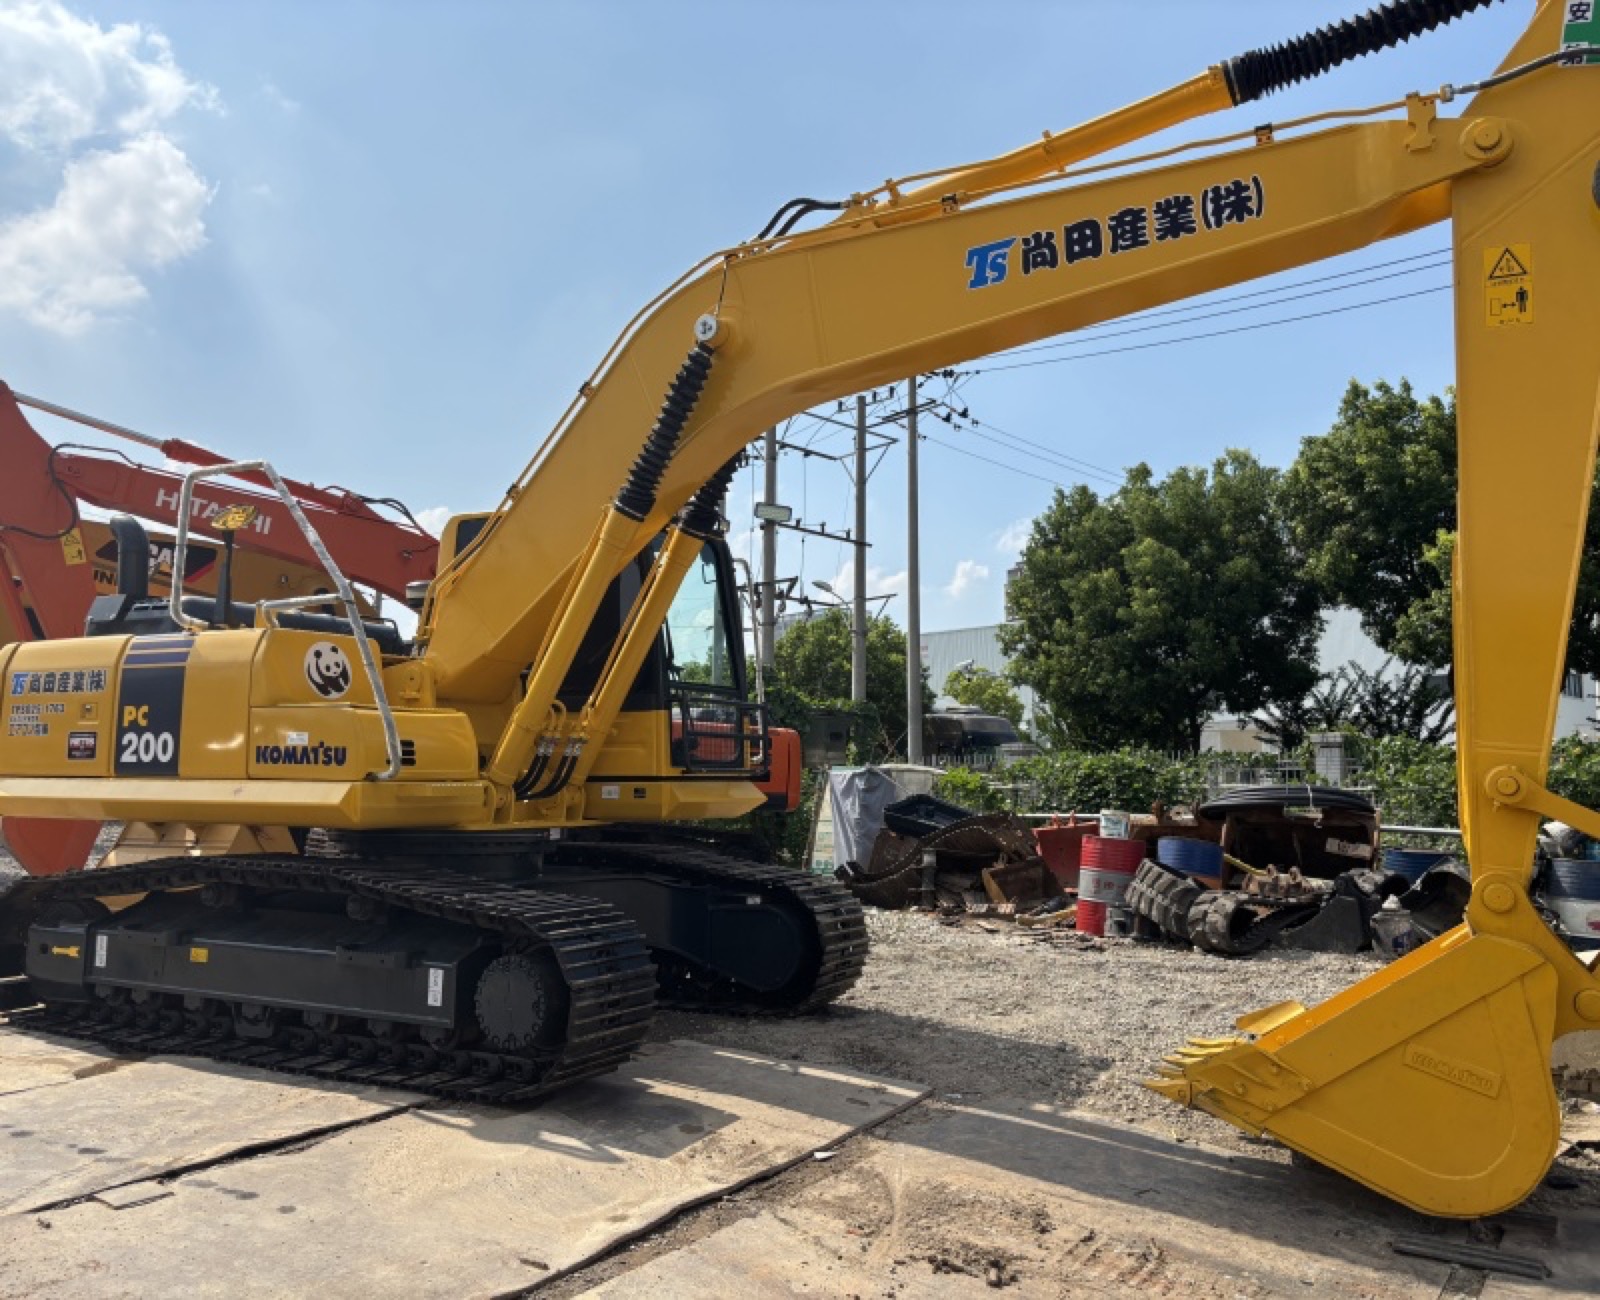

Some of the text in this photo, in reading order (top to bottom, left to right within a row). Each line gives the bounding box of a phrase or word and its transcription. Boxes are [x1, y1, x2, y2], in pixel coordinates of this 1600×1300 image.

[122, 704, 149, 728] PC
[119, 731, 174, 763] 200
[255, 740, 347, 766] KOMATSU
